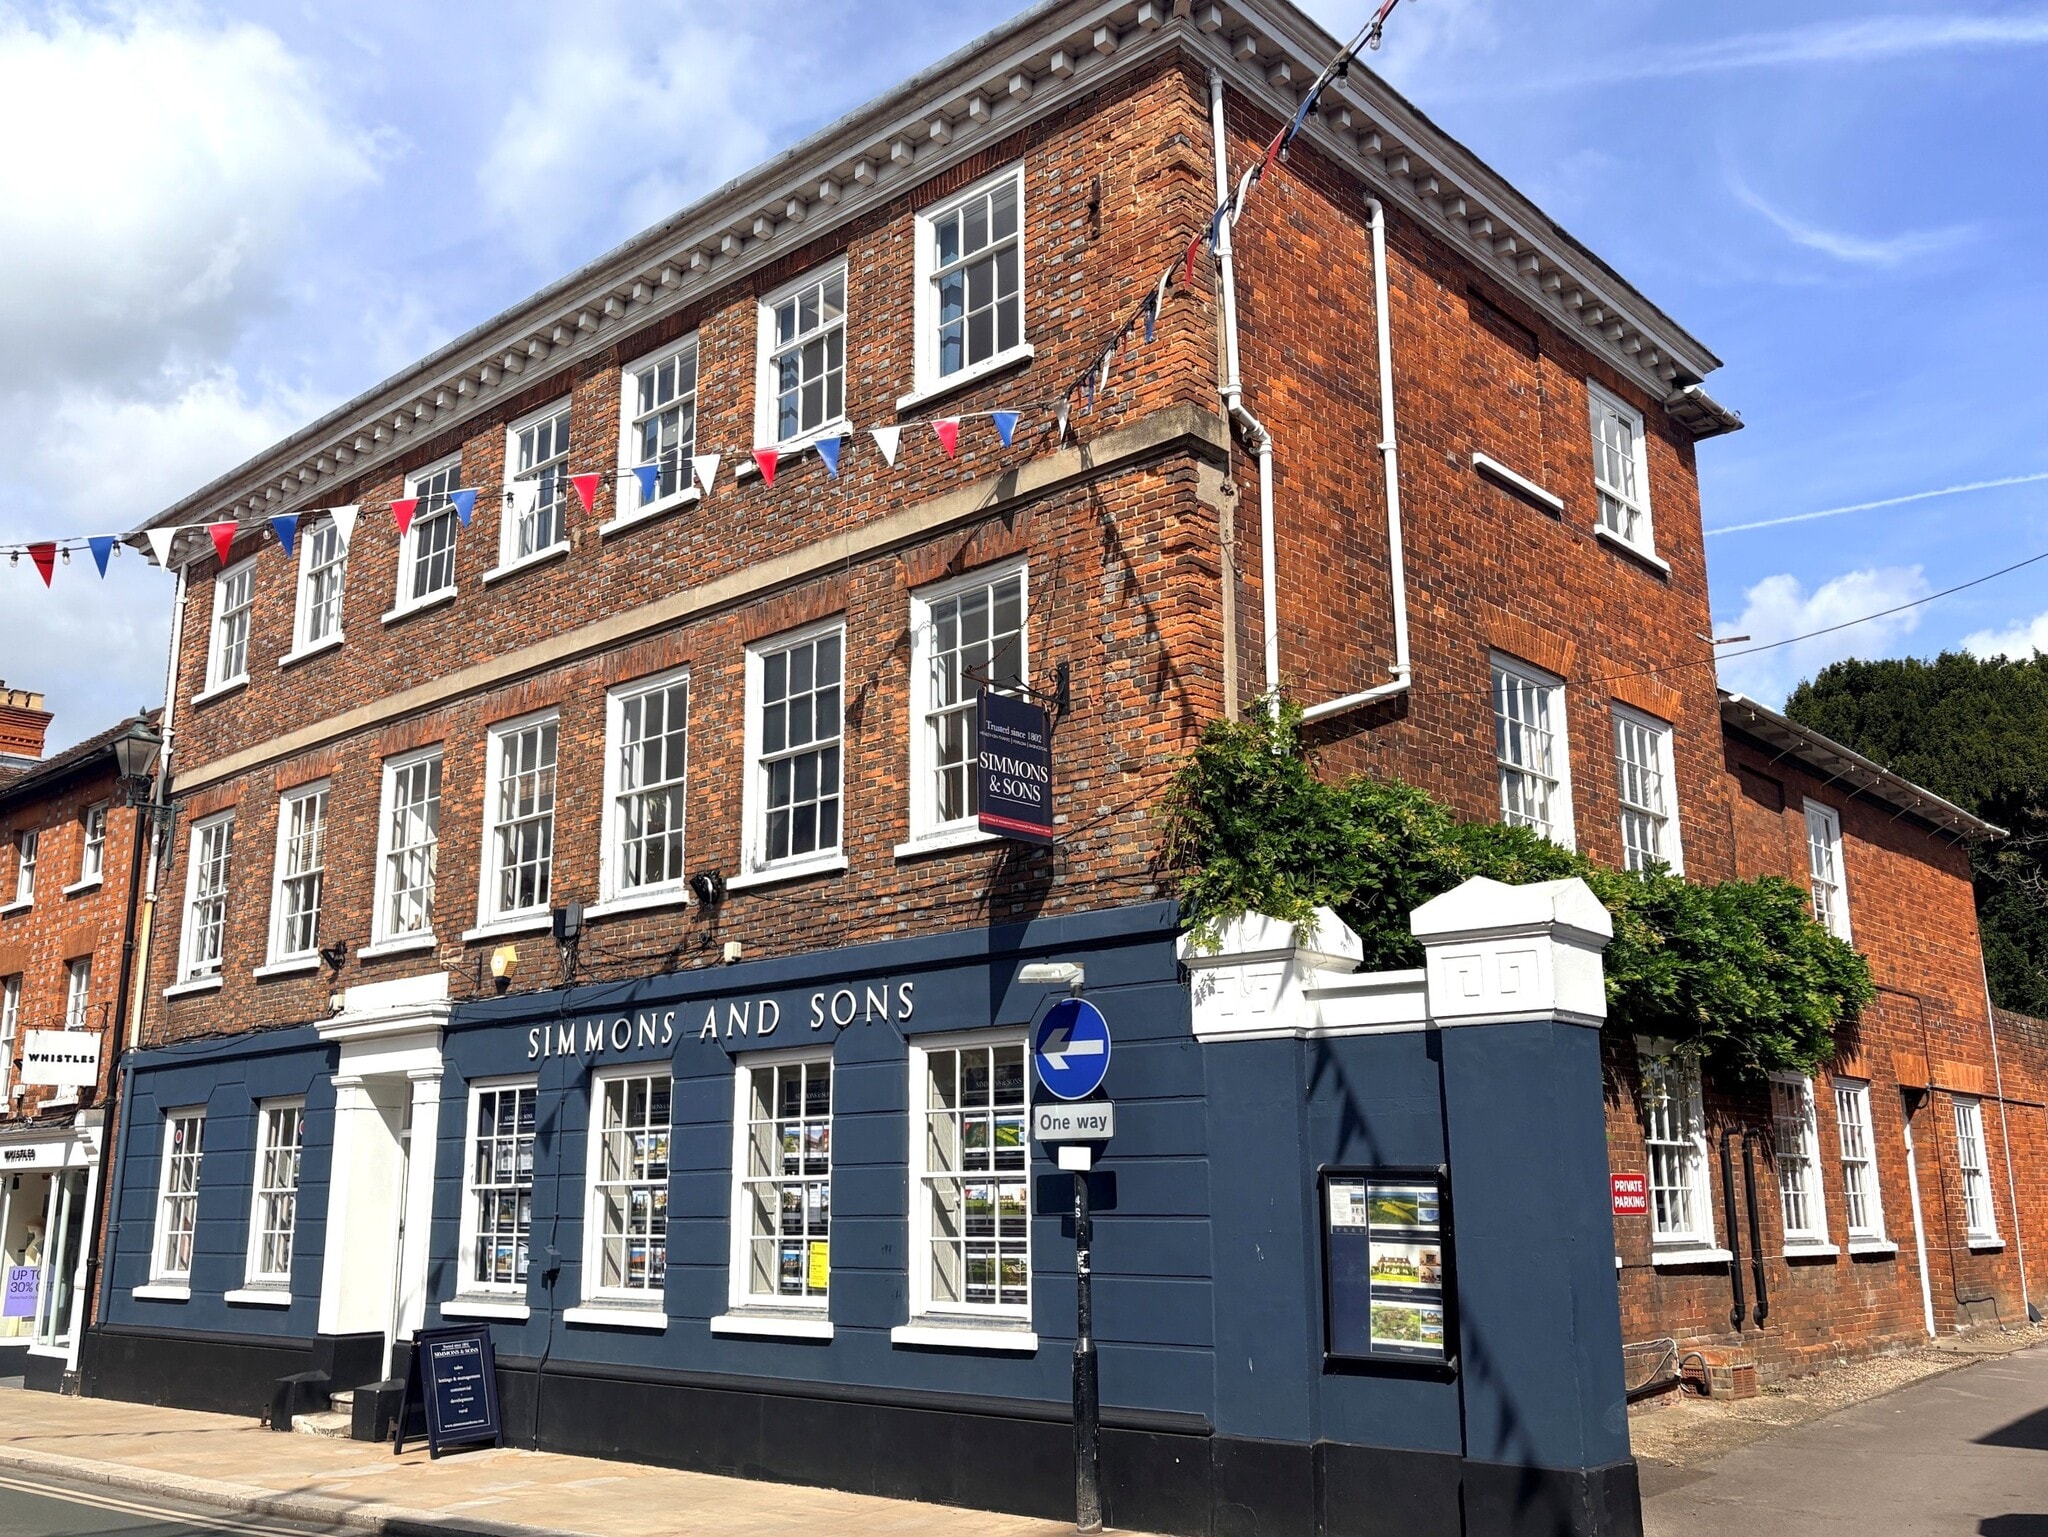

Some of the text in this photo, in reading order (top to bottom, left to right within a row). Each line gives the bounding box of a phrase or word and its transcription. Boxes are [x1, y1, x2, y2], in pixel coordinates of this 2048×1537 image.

[986, 720, 1042, 743] Trusted since 1802
[979, 751, 1049, 783] SIMMONS
[989, 774, 1041, 802] & SONS
[527, 982, 915, 1060] SIMMONS AND SONS
[28, 1053, 96, 1064] WHISTLES
[1040, 1114, 1108, 1132] One way
[1614, 1180, 1643, 1193] PRIVATE
[1614, 1195, 1645, 1208] PARKING
[12, 1269, 28, 1281] UP
[10, 1281, 34, 1293] 30%
